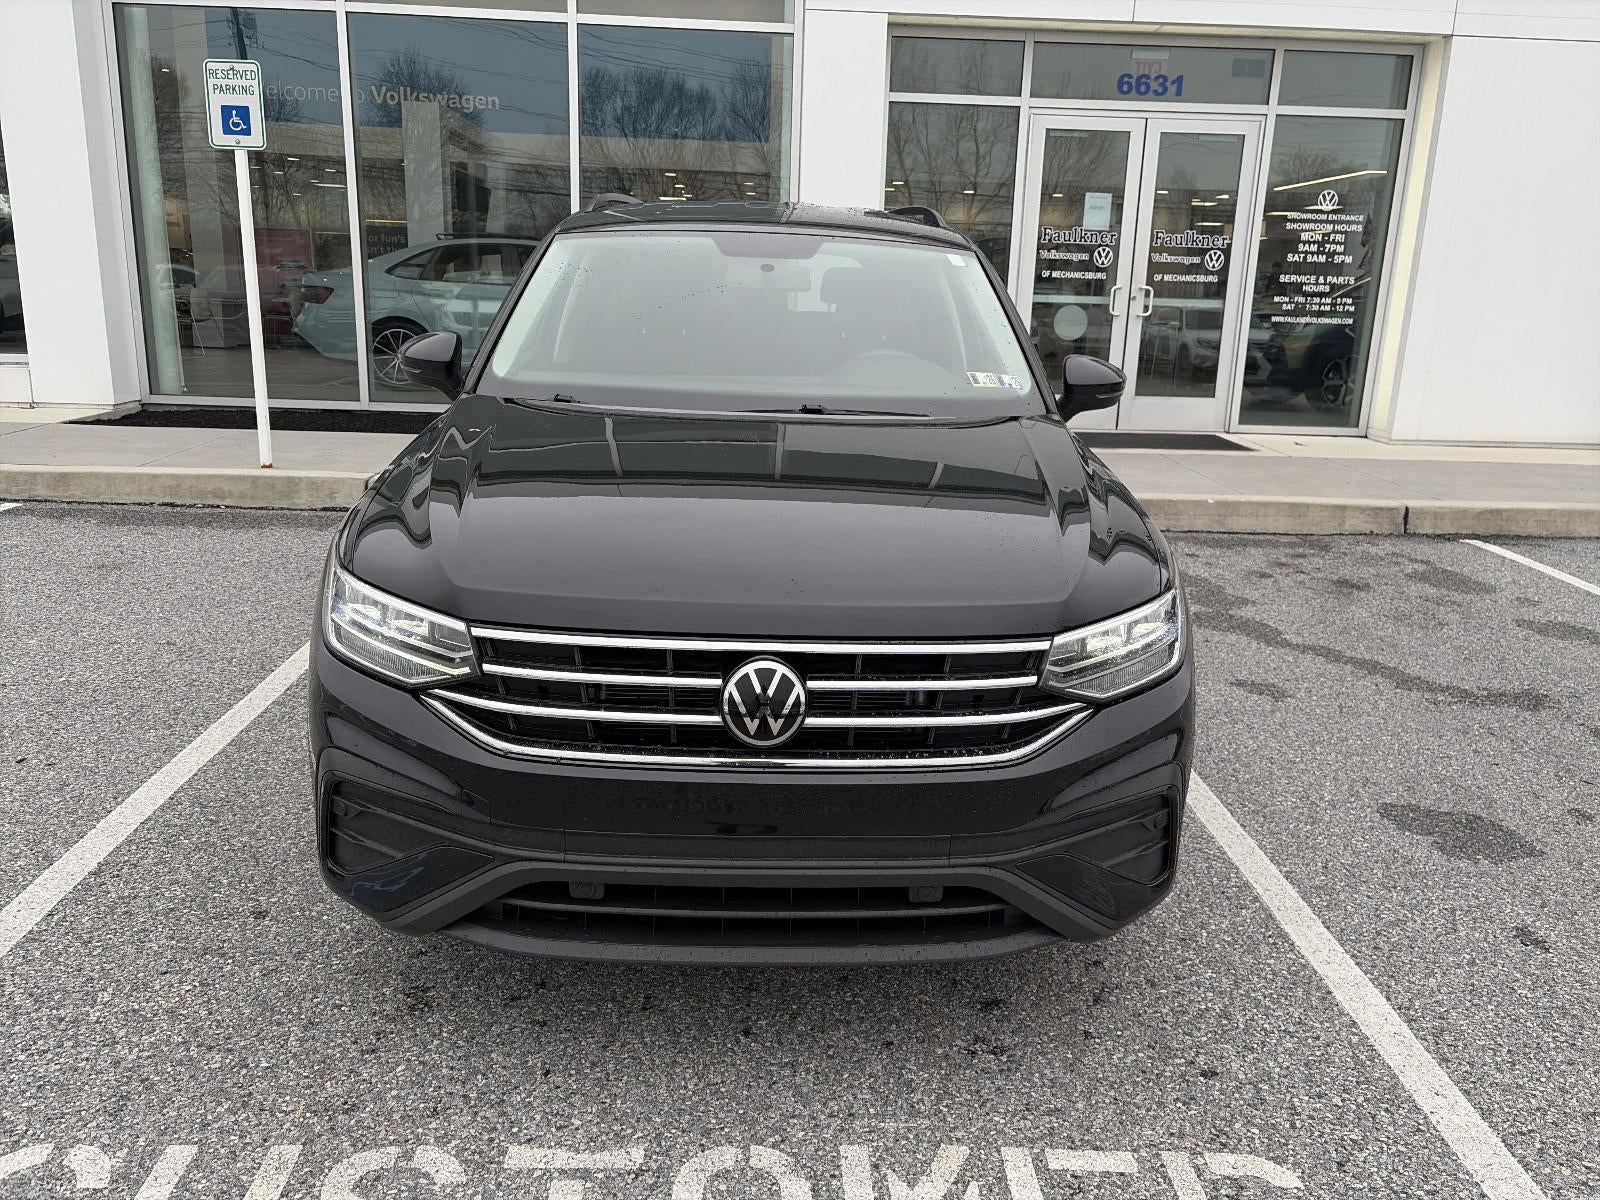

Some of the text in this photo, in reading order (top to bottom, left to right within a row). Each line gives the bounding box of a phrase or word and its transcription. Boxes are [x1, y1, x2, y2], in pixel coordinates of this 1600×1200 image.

[208, 69, 257, 80] RESERVED
[212, 84, 255, 95] PARKING
[1116, 73, 1185, 97] 6631
[263, 80, 339, 102] elcome
[371, 85, 500, 112] Volkswagen
[1287, 213, 1364, 222] SHOWROOM ENTRANCE
[1285, 222, 1363, 232] SHOWROOM HOURS
[1041, 226, 1117, 245] Faulkner
[1152, 230, 1228, 248] Faulkner
[1300, 233, 1322, 242] MON
[1329, 234, 1345, 243] FRI
[1298, 243, 1318, 252] 9AM
[1324, 244, 1344, 253] 7PM
[1039, 249, 1090, 261] Volkswagen
[1151, 253, 1201, 265] Volkswagen
[1286, 253, 1305, 262] SAT
[1306, 254, 1326, 263] 9AM
[1333, 255, 1353, 264] 5PM
[1041, 270, 1107, 280] OF MECHANICSBURG
[1153, 273, 1218, 283] OF MECHANICSBURG
[1279, 274, 1355, 285] SERVICE & PARTS
[1302, 284, 1330, 293] HOURS
[1320, 297, 1332, 305] AM
